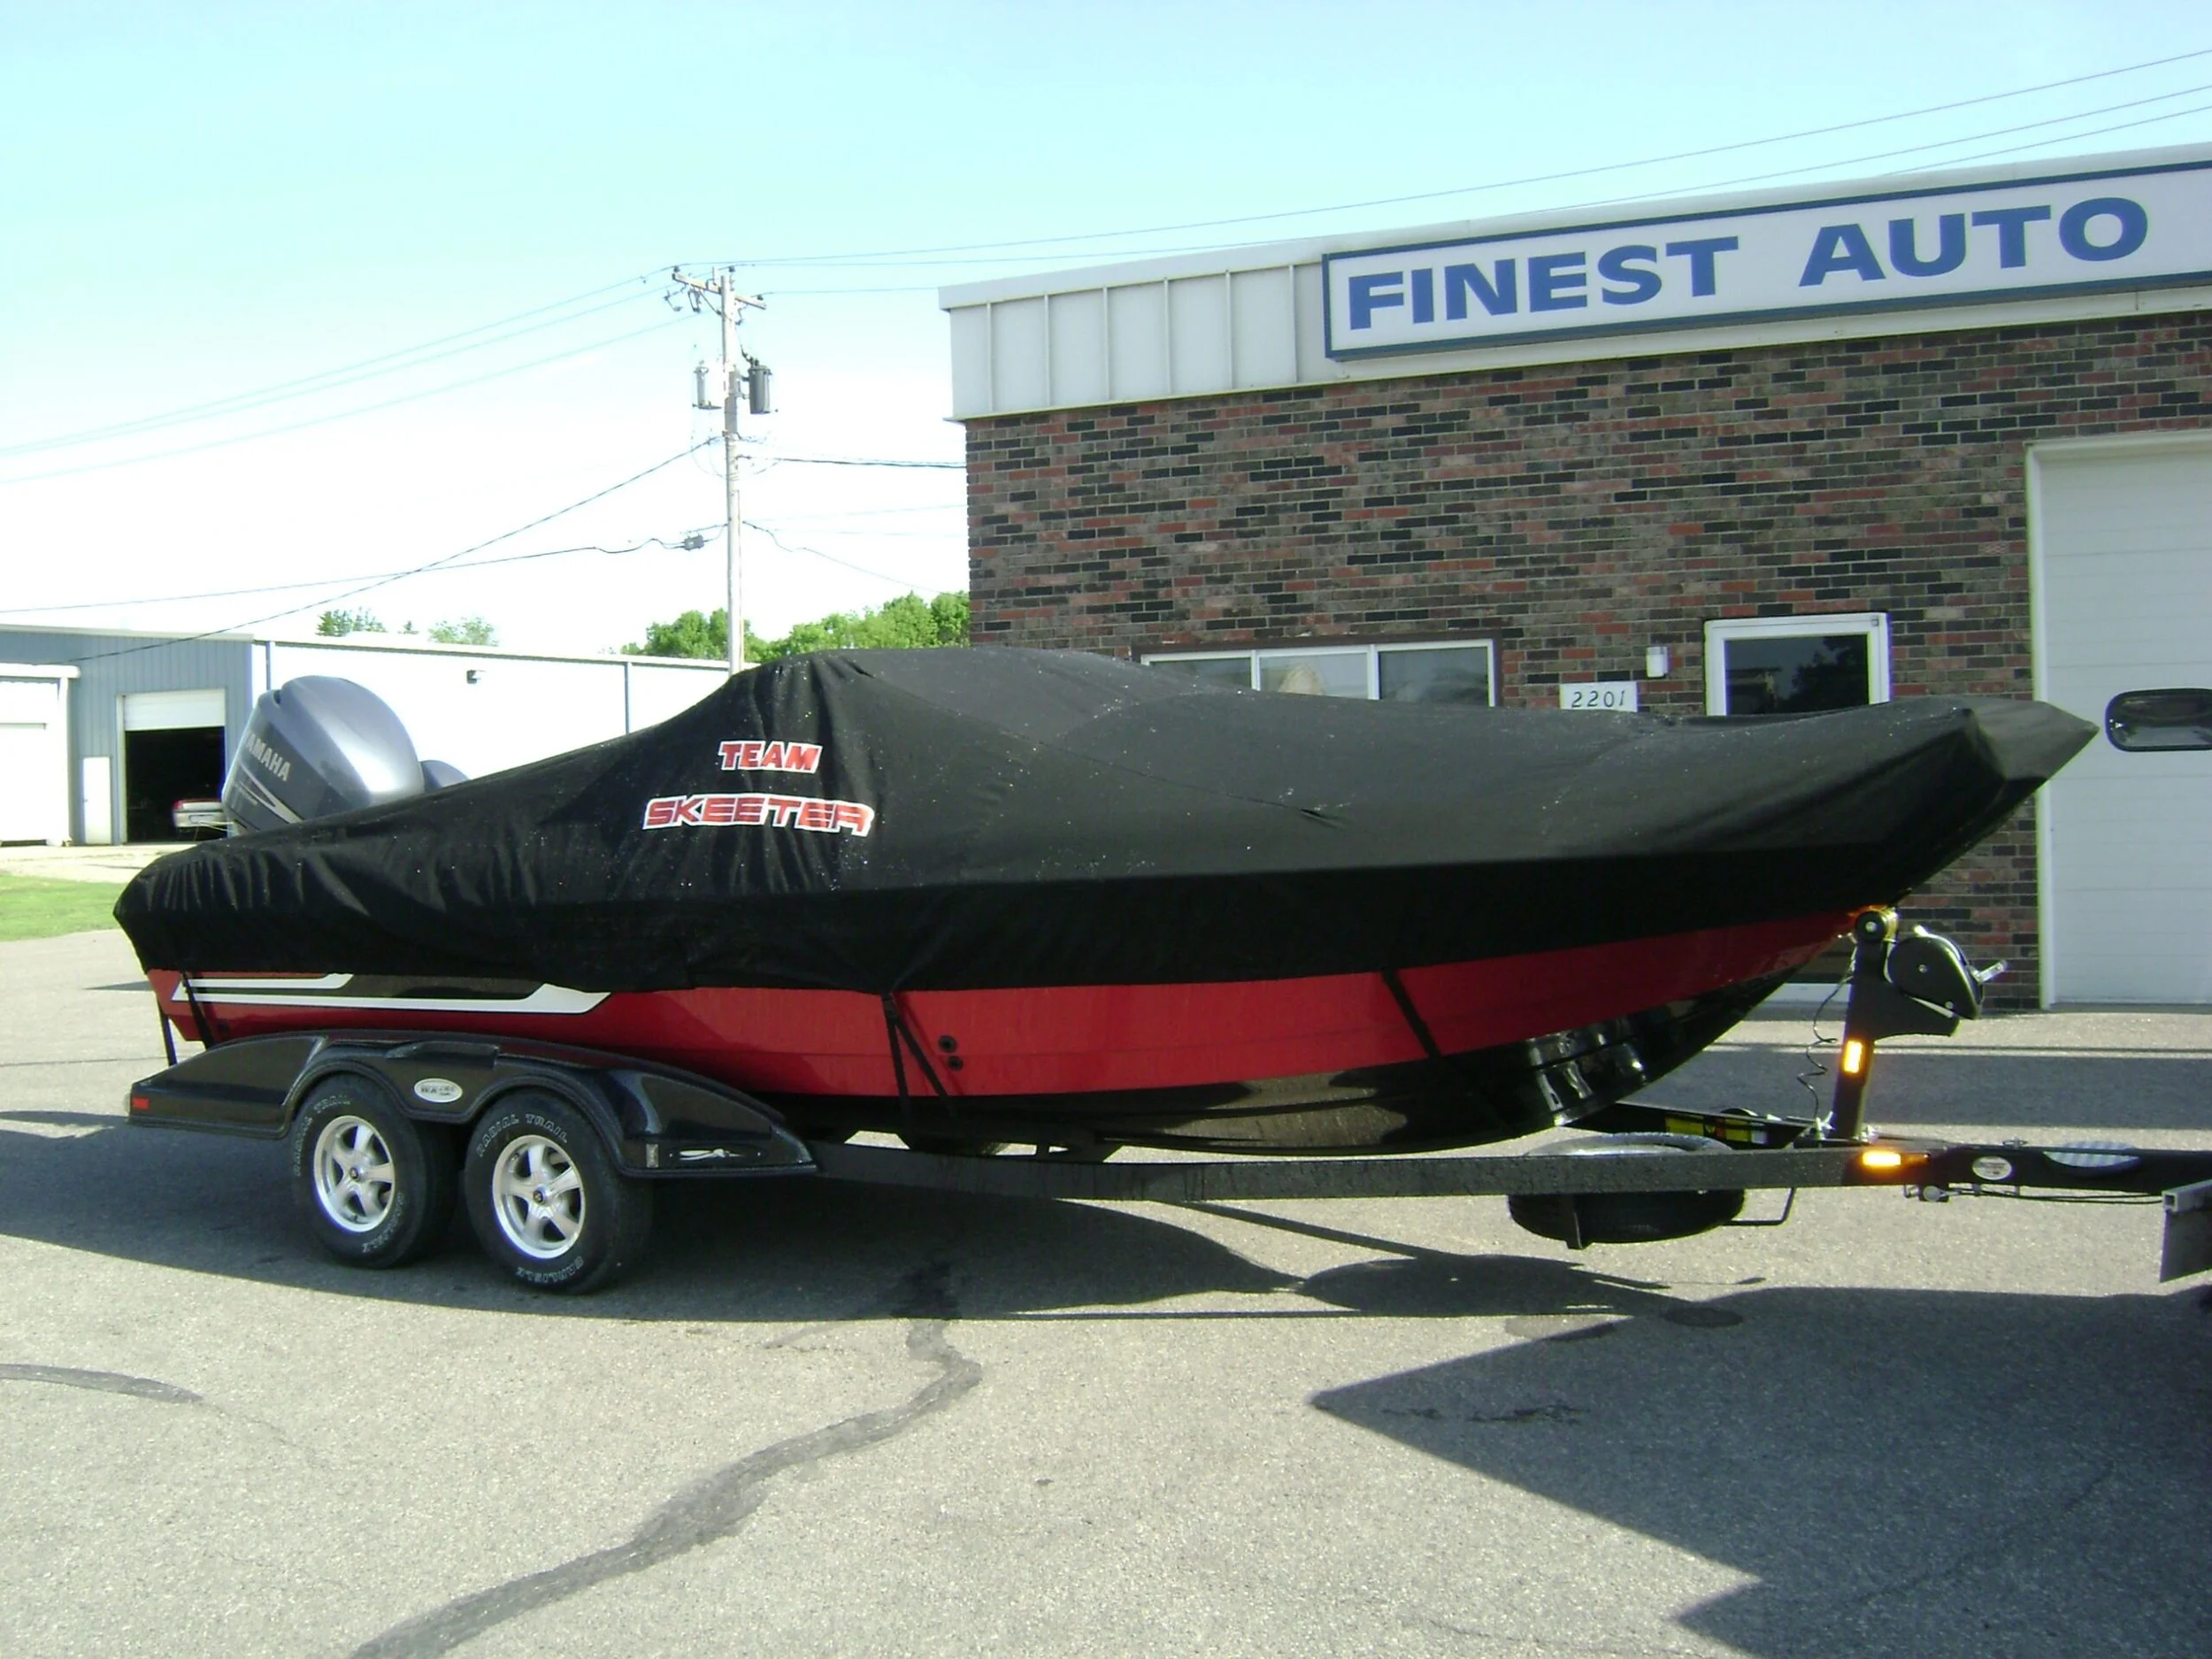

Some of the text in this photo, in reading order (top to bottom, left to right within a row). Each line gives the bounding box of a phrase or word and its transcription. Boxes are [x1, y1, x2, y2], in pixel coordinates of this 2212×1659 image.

[1348, 197, 2148, 330] FINEST AUTO
[1571, 689, 1625, 709] 2201
[243, 730, 291, 782] AMAHA
[718, 741, 823, 773] TEAM
[642, 793, 874, 836] SKEETER
[476, 1113, 568, 1157] RADIAL TRAIL
